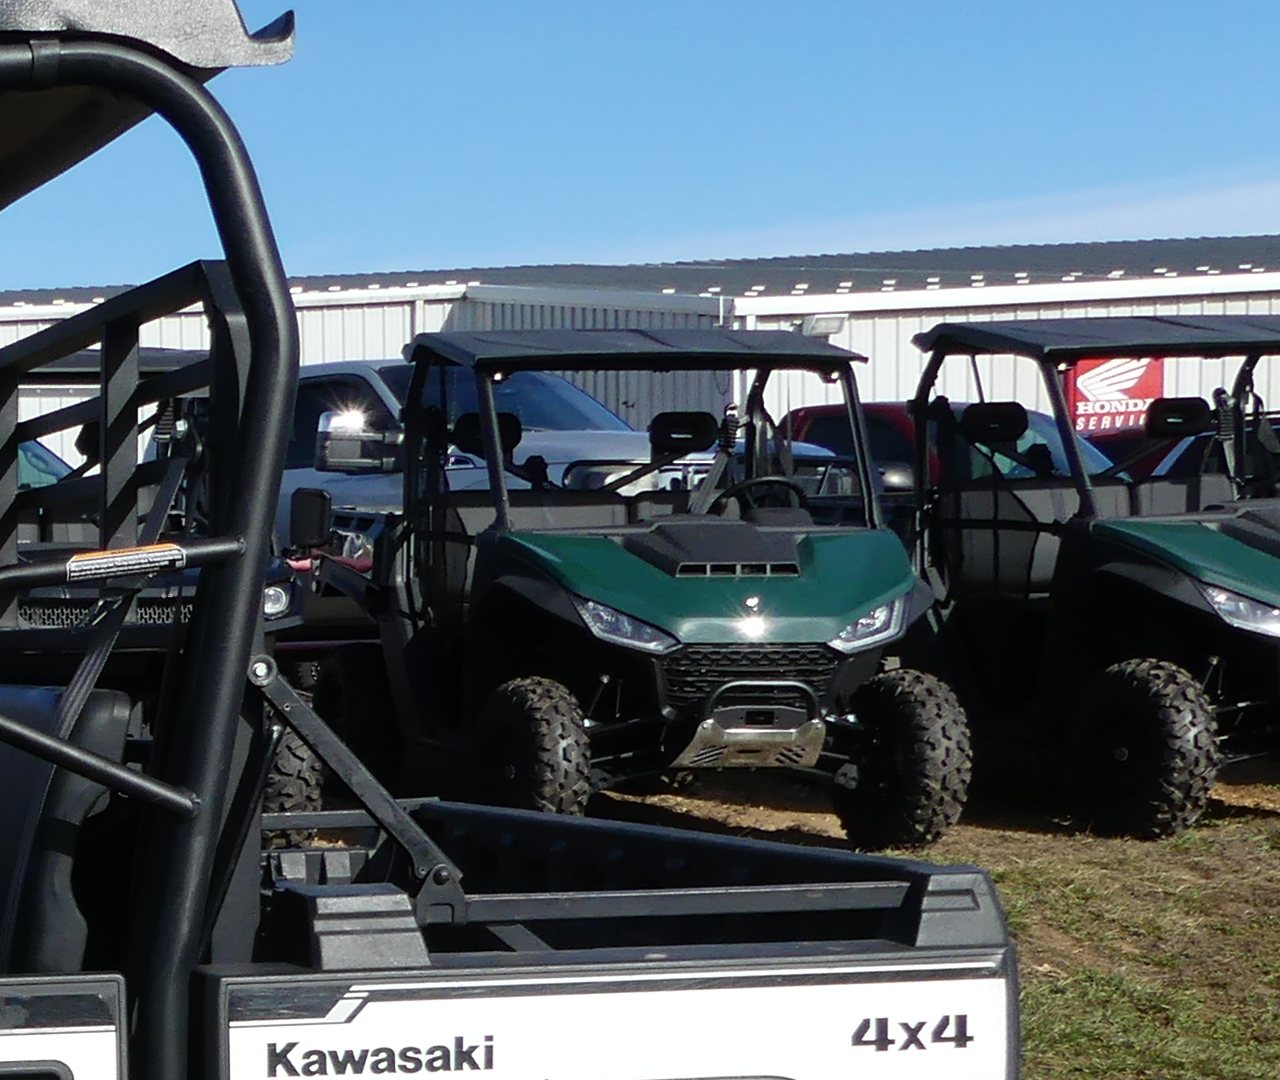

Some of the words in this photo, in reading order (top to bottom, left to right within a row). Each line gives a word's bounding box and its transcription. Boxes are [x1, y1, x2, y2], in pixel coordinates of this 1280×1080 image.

[1075, 413, 1146, 431] SERVI
[851, 1014, 975, 1052] 4x4
[267, 1035, 495, 1078] Kawasaki
